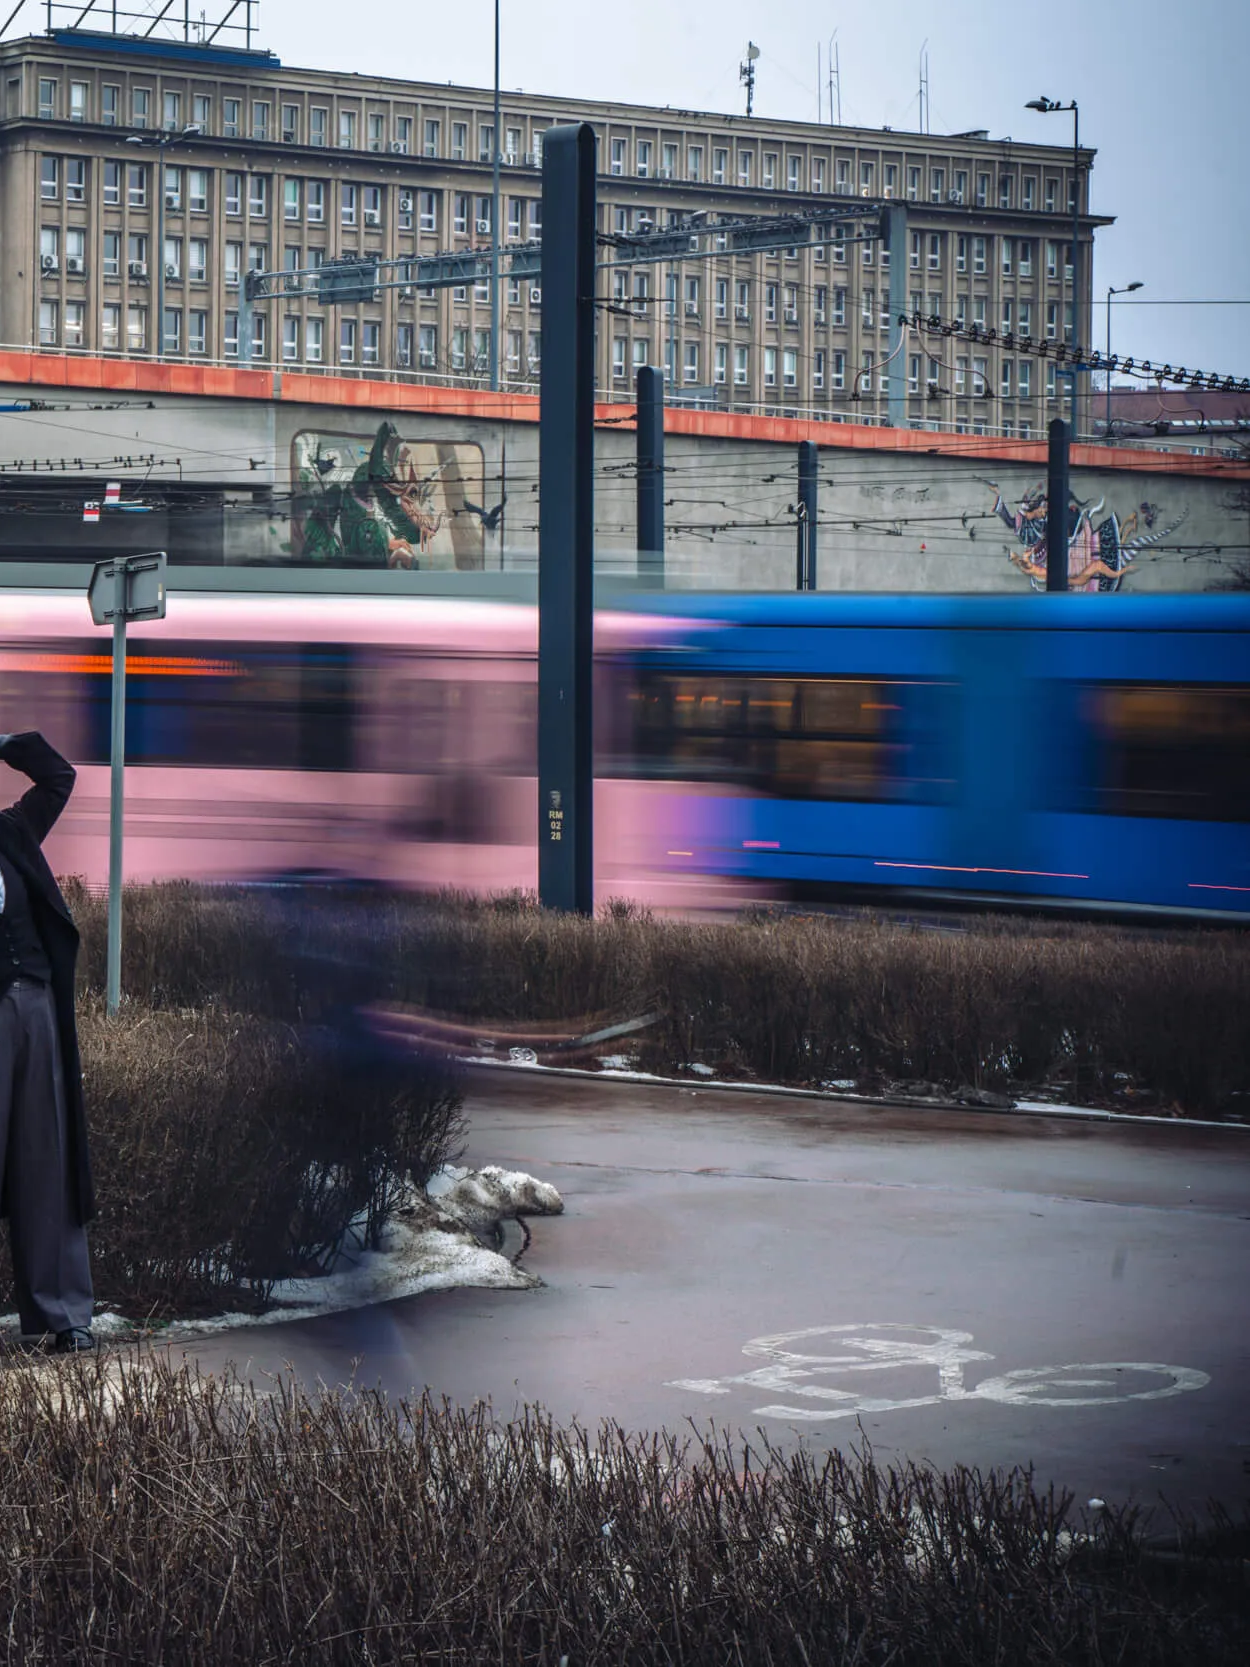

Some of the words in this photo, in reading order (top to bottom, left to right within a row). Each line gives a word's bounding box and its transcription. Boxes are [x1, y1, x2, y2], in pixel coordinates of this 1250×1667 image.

[549, 811, 563, 819] RM
[550, 821, 561, 830] 02
[550, 831, 561, 840] 28
